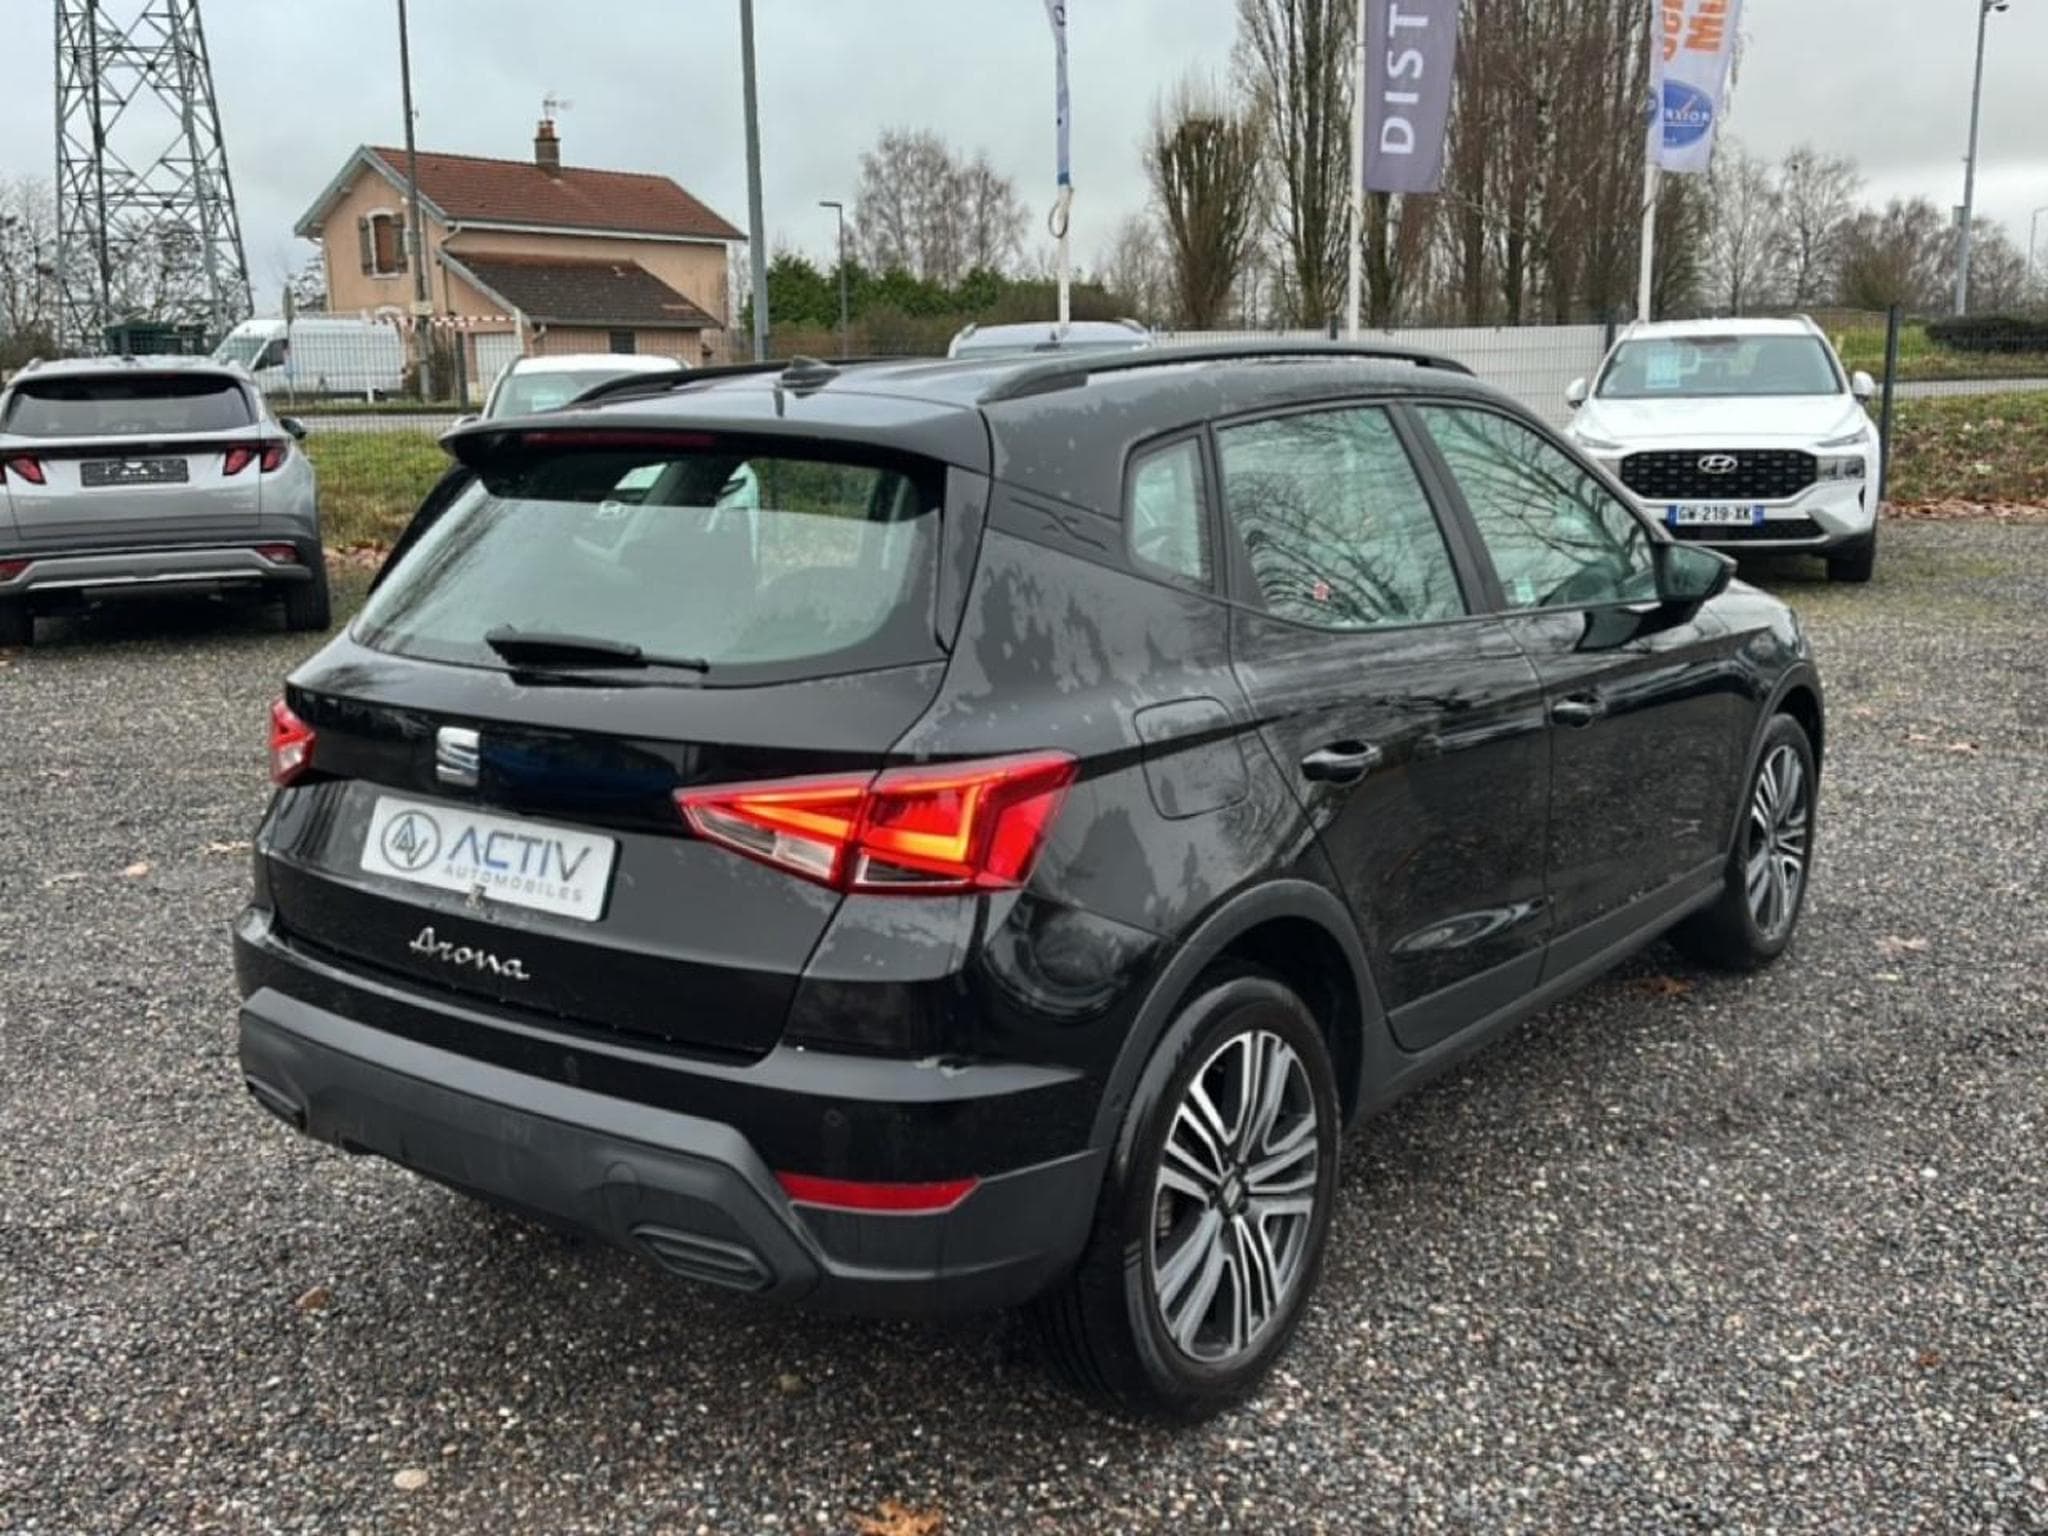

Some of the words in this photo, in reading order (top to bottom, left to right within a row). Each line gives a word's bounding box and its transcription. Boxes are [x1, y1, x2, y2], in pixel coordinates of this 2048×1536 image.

[448, 826, 592, 882] ACTIV
[443, 864, 583, 902] AUTOMOBILES
[409, 926, 531, 981] Arona
